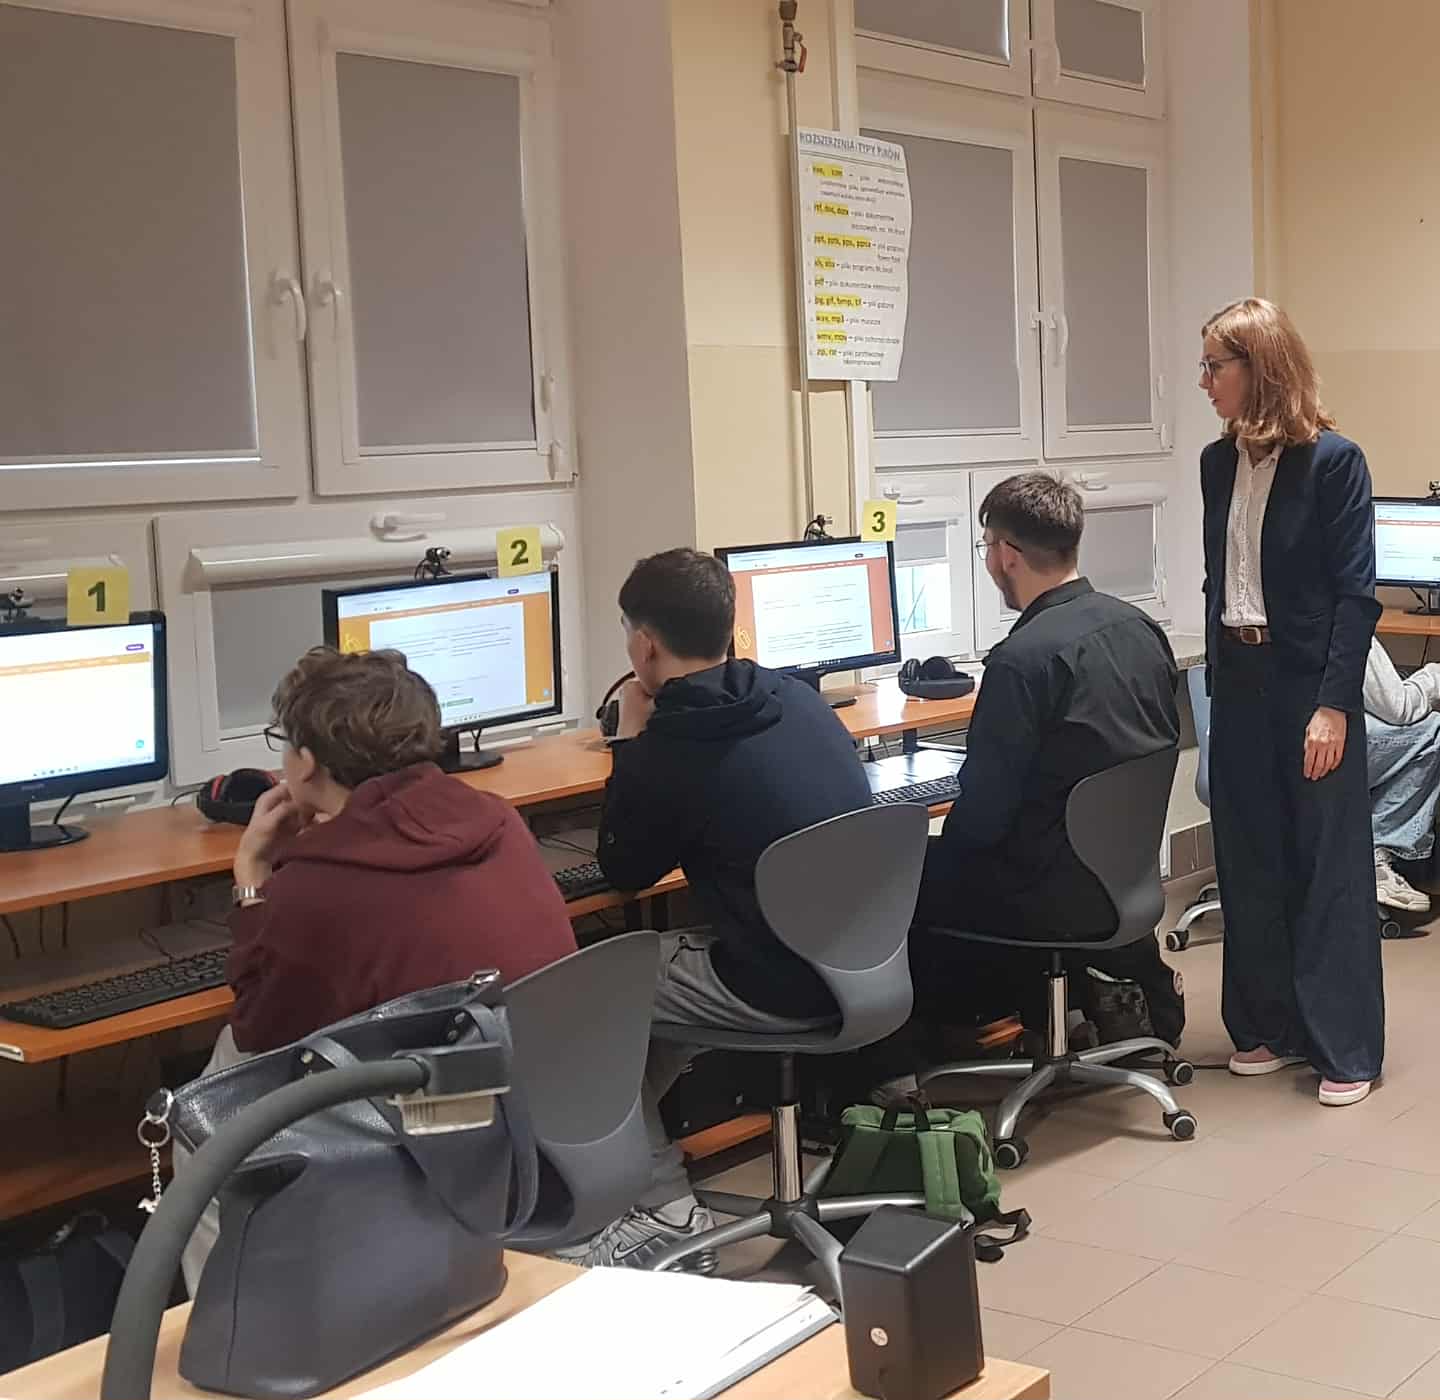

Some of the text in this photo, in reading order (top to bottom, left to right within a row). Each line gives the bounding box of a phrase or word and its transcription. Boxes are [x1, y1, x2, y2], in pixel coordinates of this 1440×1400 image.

[871, 511, 886, 533] 3
[510, 539, 529, 566] 2
[87, 580, 106, 612] 1
